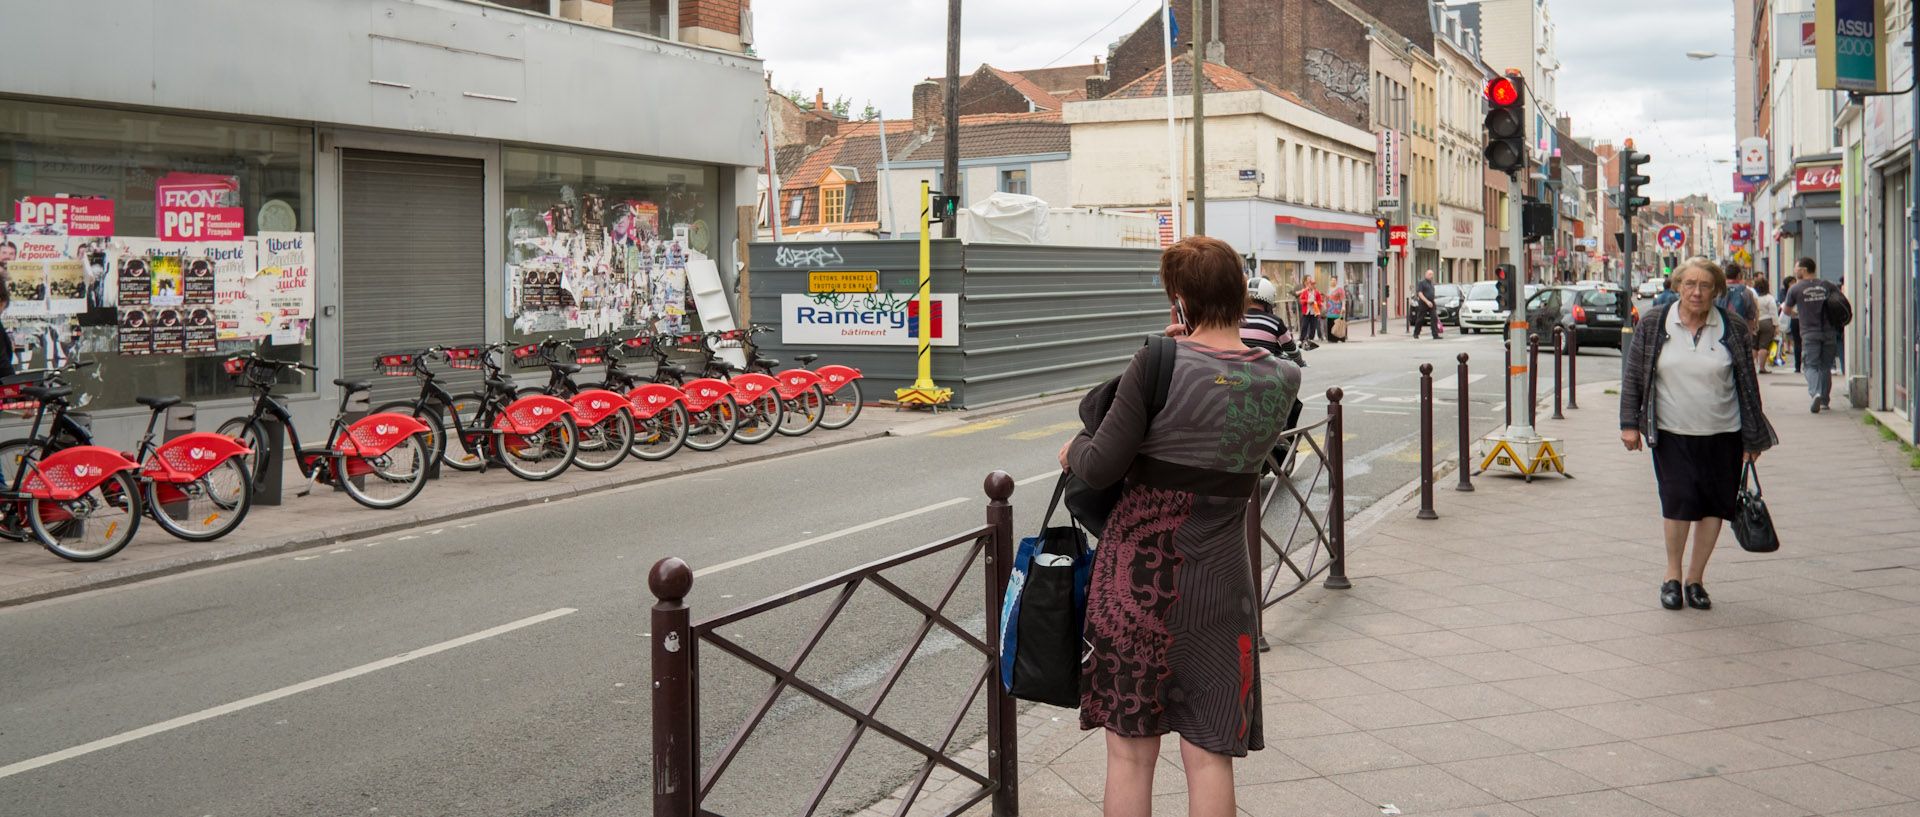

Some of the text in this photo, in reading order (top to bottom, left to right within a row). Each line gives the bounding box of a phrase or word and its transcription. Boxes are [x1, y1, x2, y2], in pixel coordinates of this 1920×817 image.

[1837, 18, 1873, 38] ASSU
[1838, 38, 1874, 57] 2000
[1799, 171, 1818, 186] Le
[20, 201, 68, 225] PCF
[70, 205, 88, 214] Parti
[70, 213, 111, 223] Communiste
[206, 213, 222, 221] Parti
[70, 222, 100, 232] Français
[164, 211, 205, 237] PCF
[206, 221, 241, 229] Communiste
[207, 228, 232, 237] Français
[1390, 231, 1408, 239] SFR
[23, 242, 55, 252] Prenez
[266, 235, 303, 255] Liberté
[19, 251, 61, 261] le pouvoir
[296, 266, 308, 277] de
[797, 307, 904, 329] Ramery
[841, 328, 887, 336] bâtiment
[88, 466, 103, 474] lille
